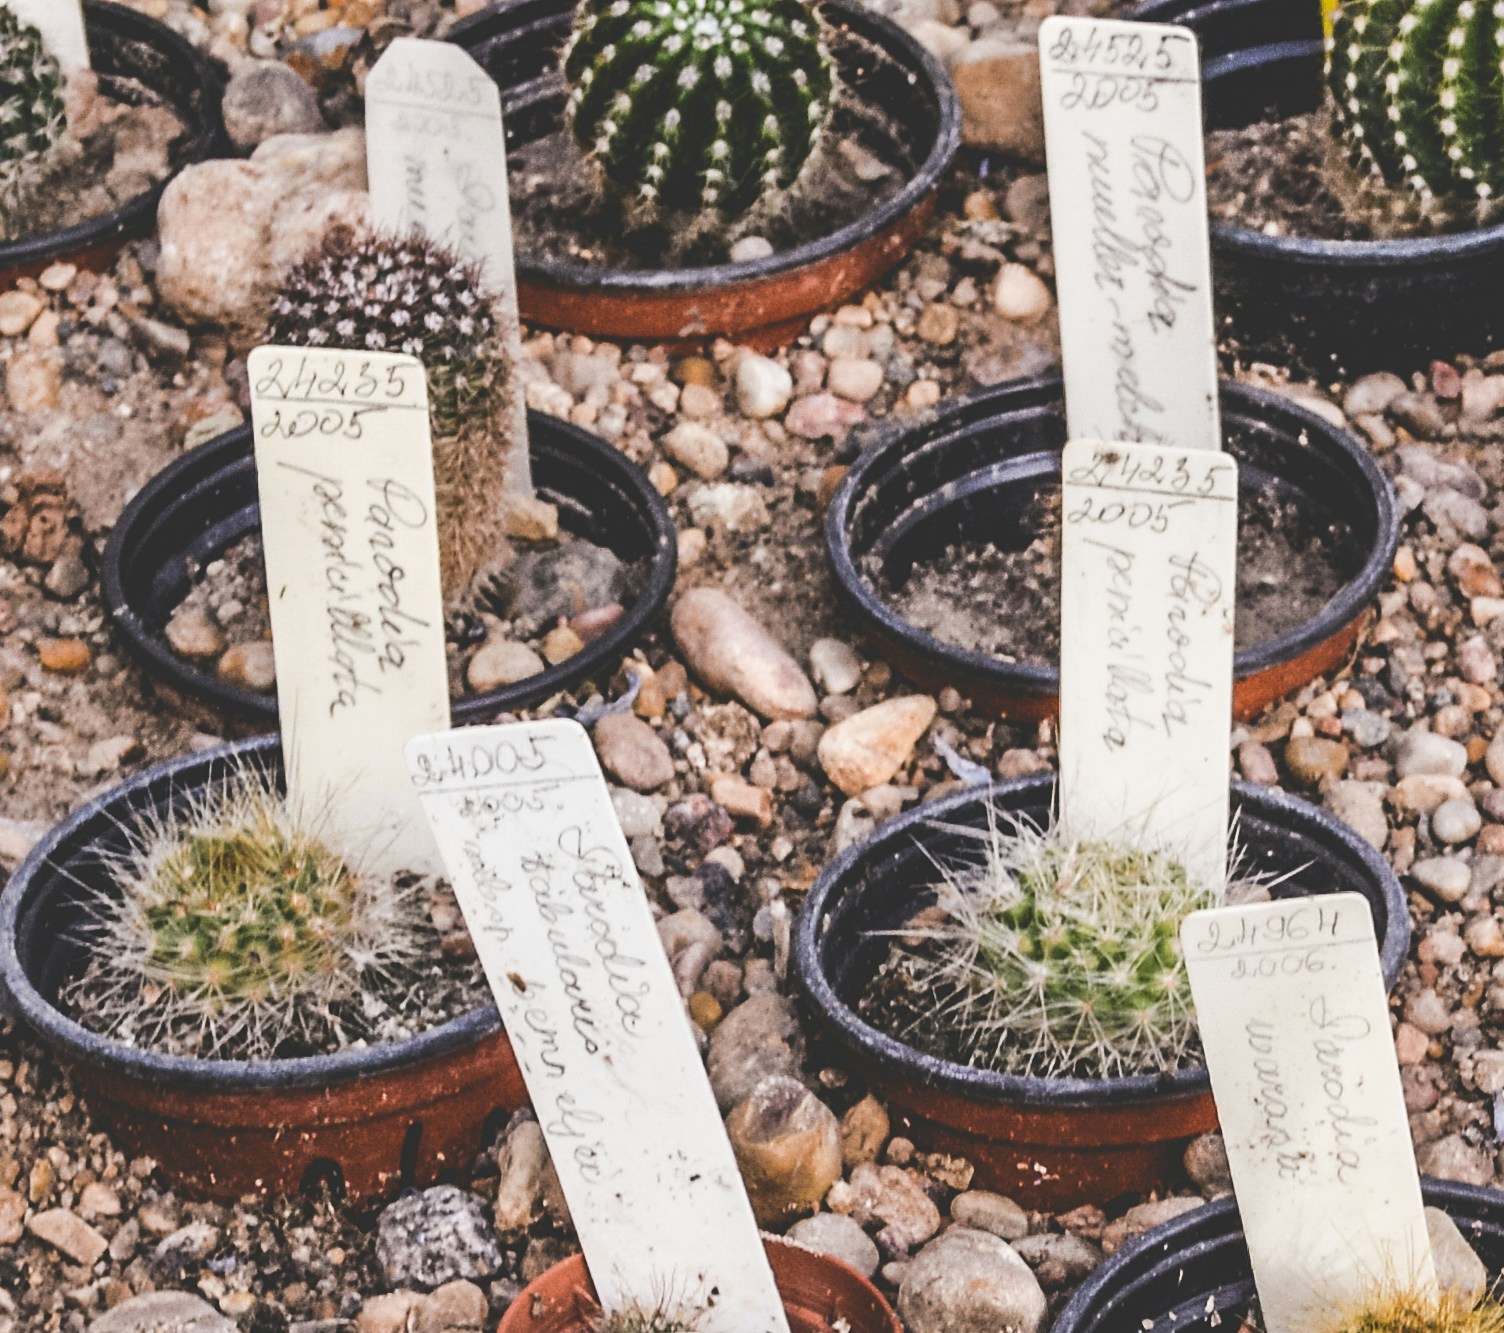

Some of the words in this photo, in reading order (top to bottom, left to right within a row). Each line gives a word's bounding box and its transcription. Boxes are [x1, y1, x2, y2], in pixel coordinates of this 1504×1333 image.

[1049, 28, 1193, 74] 24525
[1128, 132, 1198, 336] Parodia
[255, 360, 409, 402] 24235
[259, 406, 391, 442] 2005
[1069, 452, 1218, 492] 24235
[1068, 500, 1194, 536] 2005
[364, 476, 430, 673] Parodia
[1084, 537, 1157, 755] penicillata
[1165, 550, 1225, 741] Parodia
[408, 732, 545, 788] 24005
[561, 822, 661, 1043] Parodia
[1195, 909, 1340, 953] 24964
[1307, 995, 1383, 1187] Parodia
